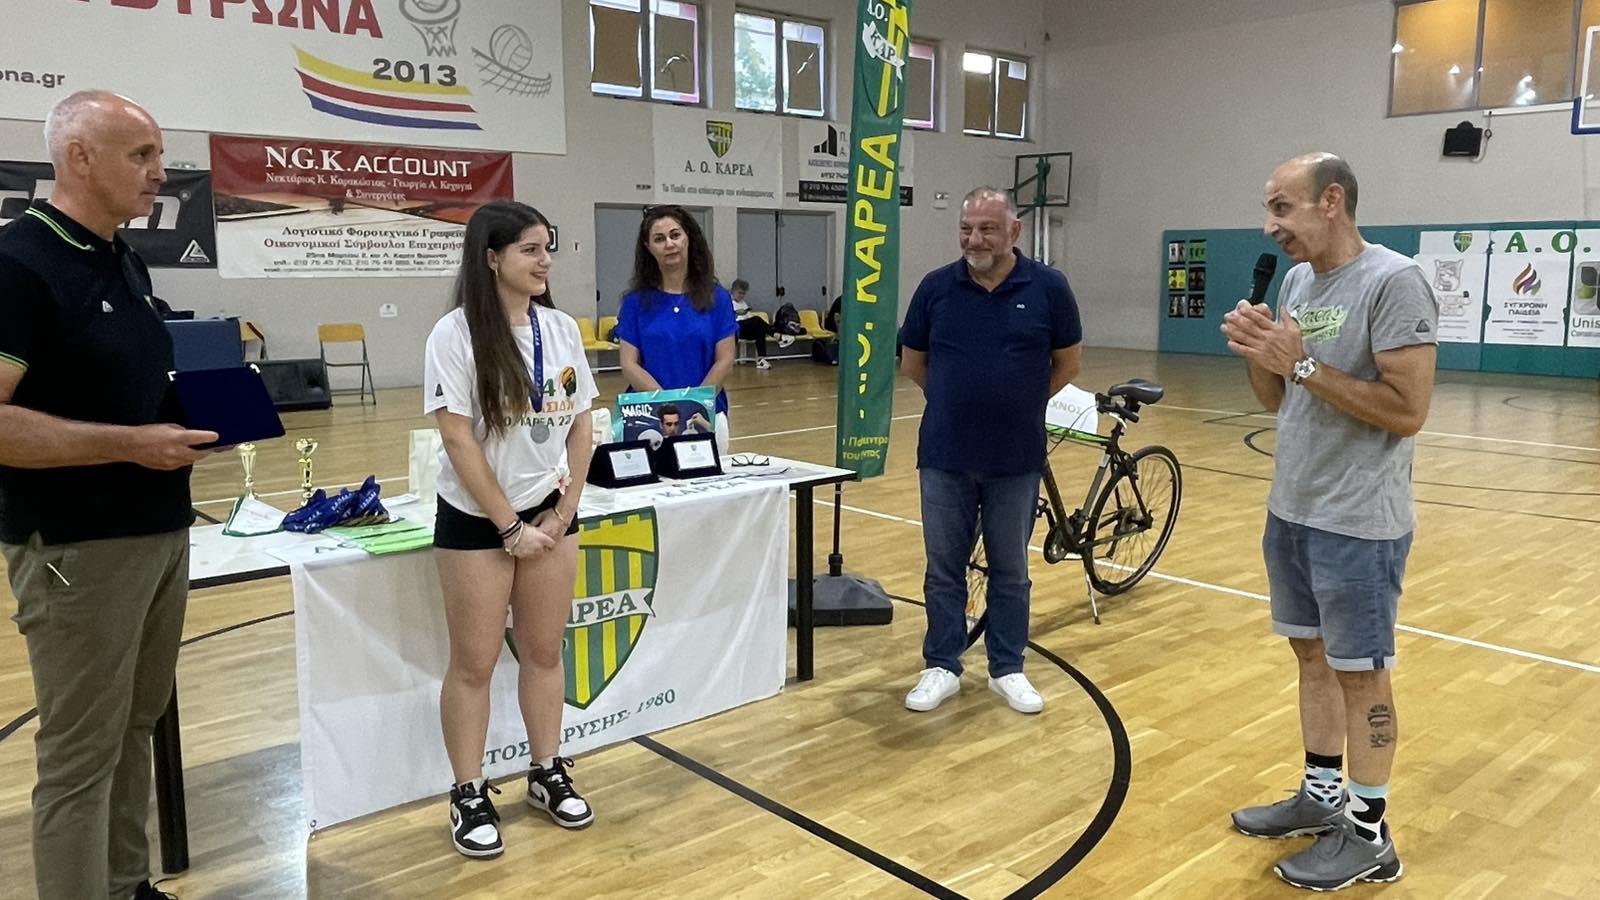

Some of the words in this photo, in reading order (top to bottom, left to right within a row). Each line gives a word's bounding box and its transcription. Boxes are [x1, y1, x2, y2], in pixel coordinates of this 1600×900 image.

[110, 0, 383, 39] ΡΩΝΑ
[0, 70, 65, 88] na.gr
[373, 58, 457, 87] 2013
[715, 163, 754, 176] ΚΑΡΕΑ
[265, 172, 316, 184] Νεκτάριος
[345, 188, 354, 198] &
[854, 133, 898, 303] ΚΑΡΕΑ
[282, 226, 343, 237] Λογιστικό
[346, 227, 420, 239] Φοροτεχνικό
[263, 238, 341, 249] Οικονομικοί
[344, 239, 405, 250] Σύμβουλοι
[621, 403, 653, 418] MAGIC
[569, 593, 637, 624] ΡΕΑ
[481, 741, 530, 767] ΤΟΣ
[559, 708, 632, 745] ΡΥΣΗΣ:
[636, 689, 676, 713] 1980
